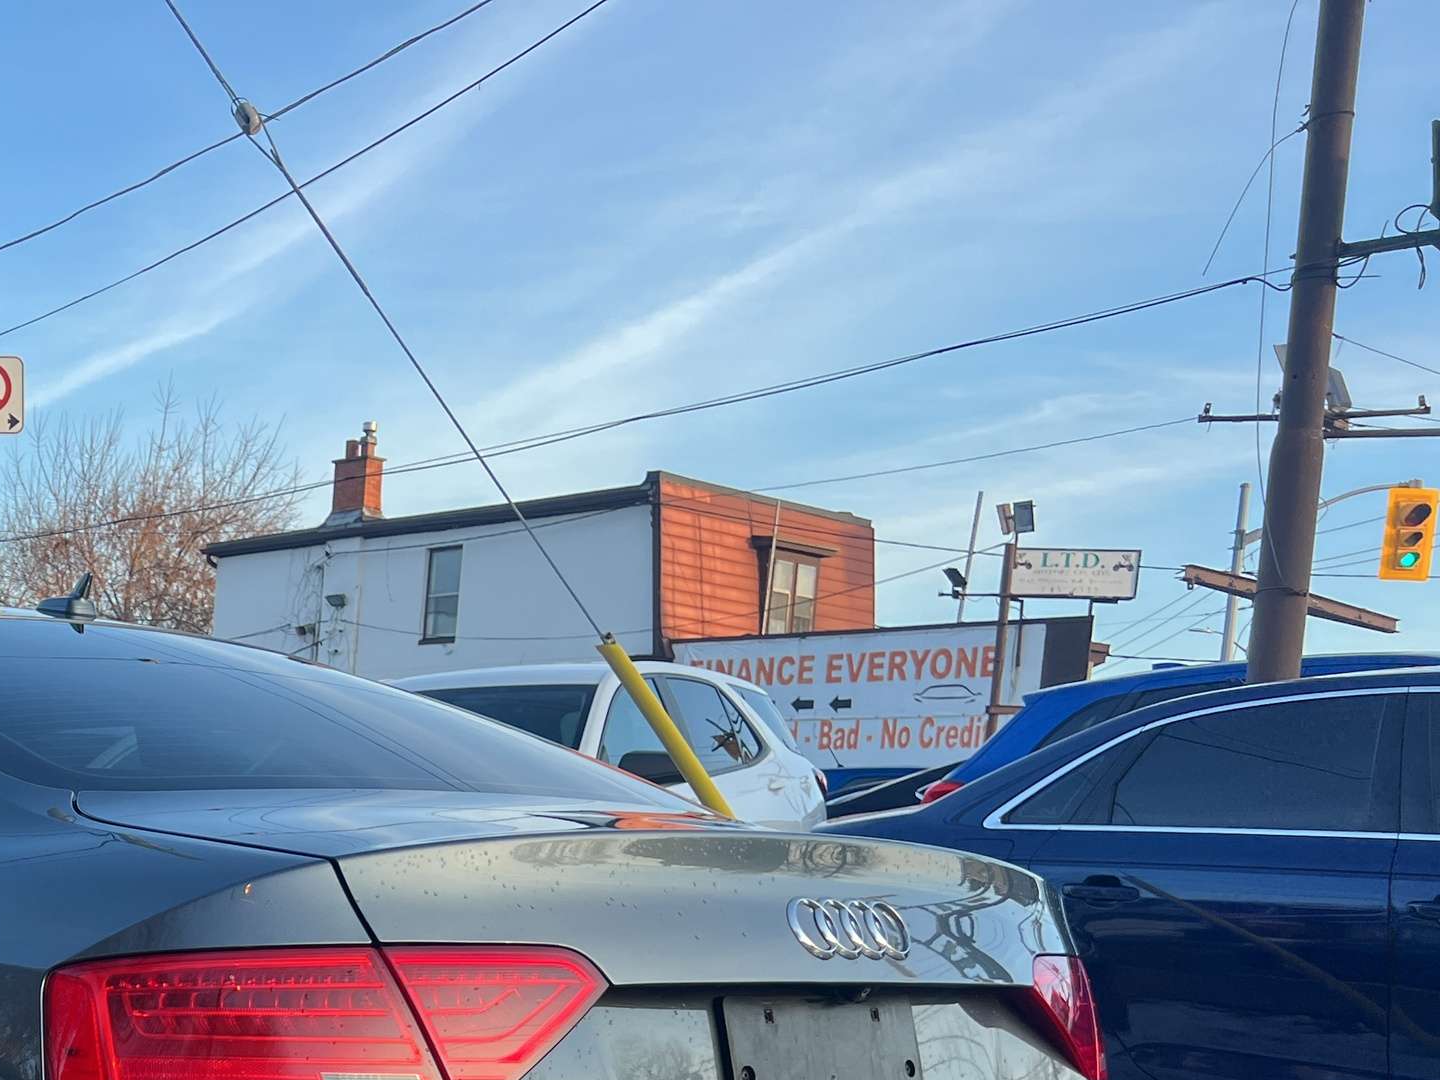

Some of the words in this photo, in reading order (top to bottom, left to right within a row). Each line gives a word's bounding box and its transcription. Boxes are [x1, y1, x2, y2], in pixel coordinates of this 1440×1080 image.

[689, 655, 815, 686] NANCE
[825, 646, 996, 684] EVERYONE
[817, 719, 861, 750] Bad
[880, 717, 911, 749] No
[918, 715, 988, 749] Credi
